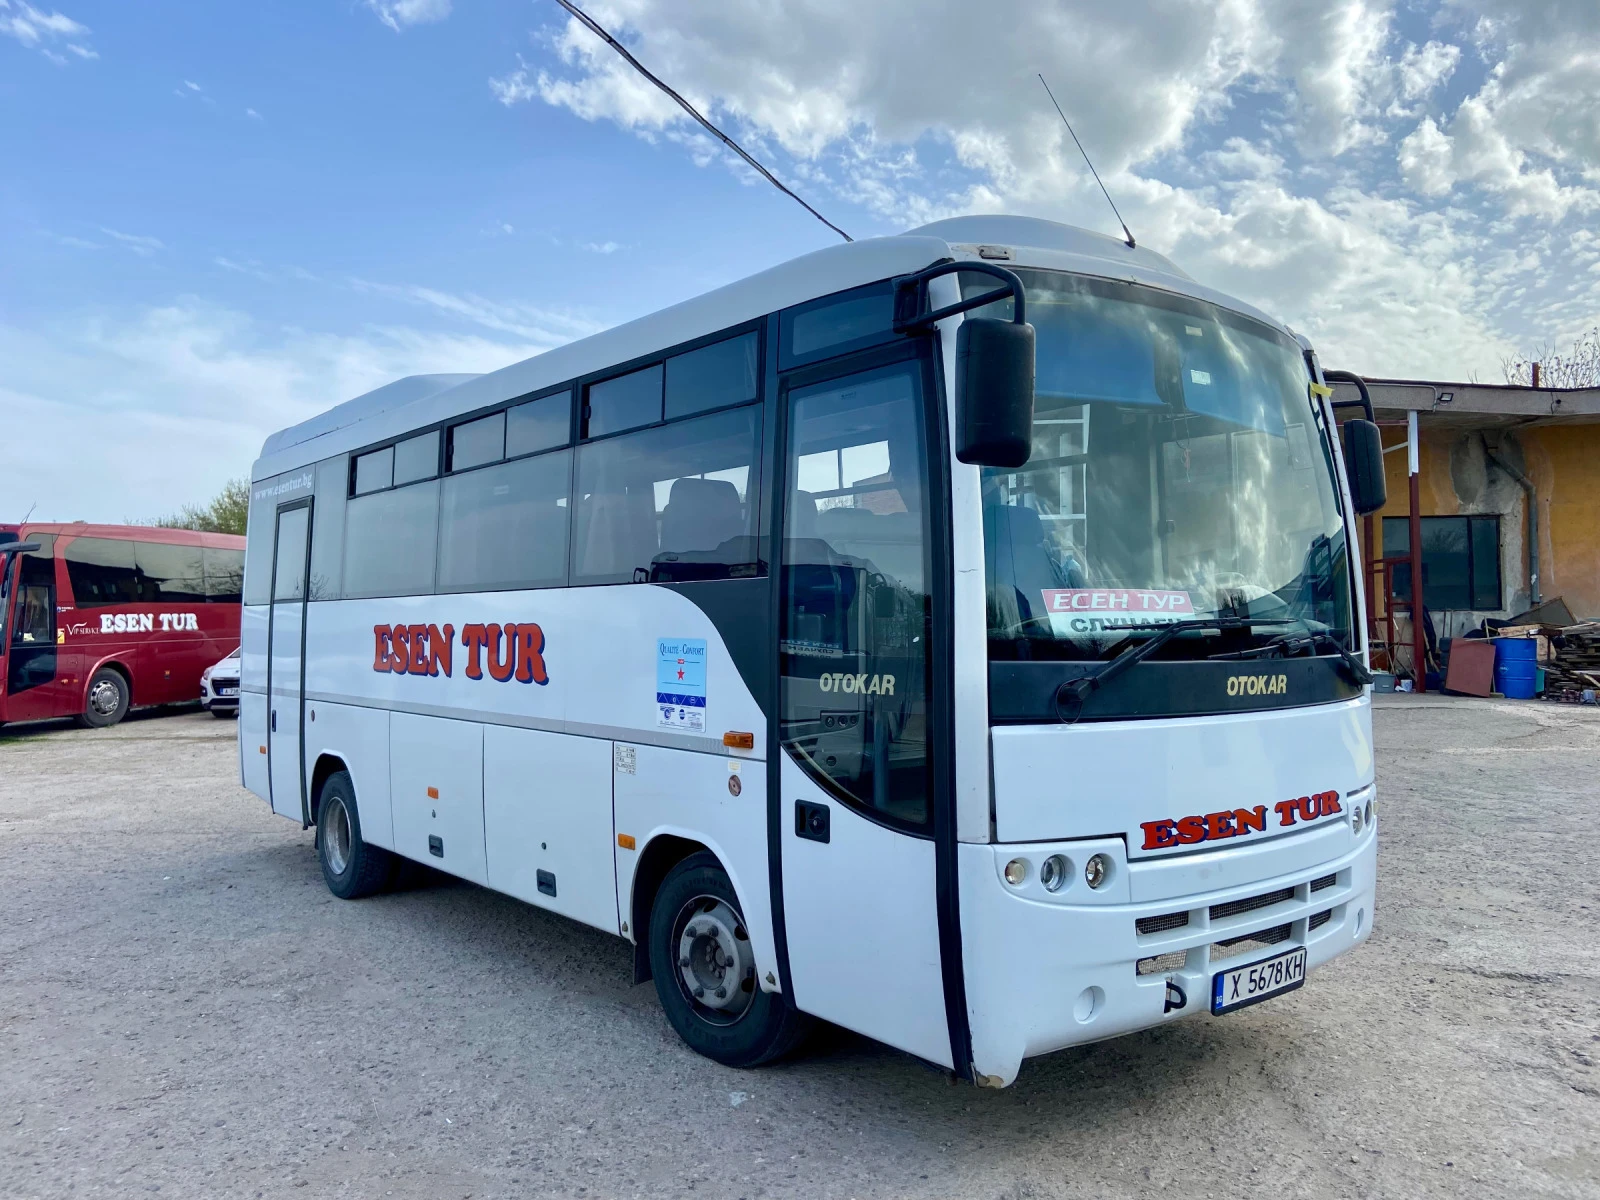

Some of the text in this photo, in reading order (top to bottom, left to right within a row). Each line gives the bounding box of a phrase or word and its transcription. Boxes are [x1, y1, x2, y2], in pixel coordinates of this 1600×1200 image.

[255, 473, 312, 500] www.esentur.bg
[1053, 593, 1185, 609] ЕСЕН ТУР
[100, 612, 199, 633] ESEN TUR
[1070, 618, 1182, 632] СЛУЧА
[373, 622, 550, 686] ESEN TUR
[819, 672, 896, 696] OTOKAR
[1226, 674, 1288, 696] OTOKAR
[1140, 790, 1343, 851] ESEN TUR
[1231, 973, 1242, 1000] X
